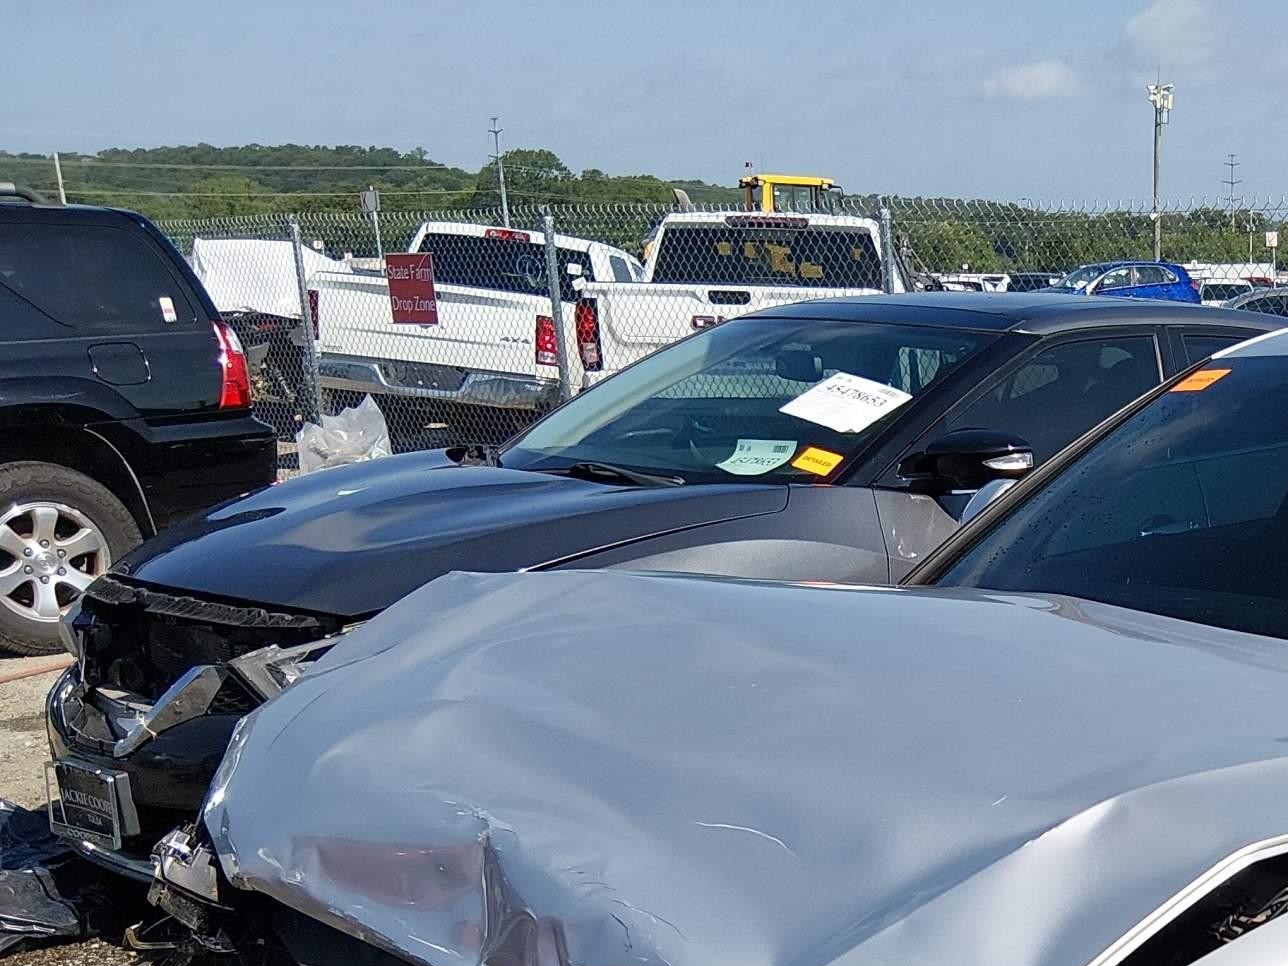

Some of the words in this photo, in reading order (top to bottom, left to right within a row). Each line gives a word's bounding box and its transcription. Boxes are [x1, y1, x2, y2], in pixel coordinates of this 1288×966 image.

[388, 264, 409, 280] State
[410, 264, 433, 282] Farm
[392, 296, 413, 314] Drop
[414, 296, 436, 312] Zone
